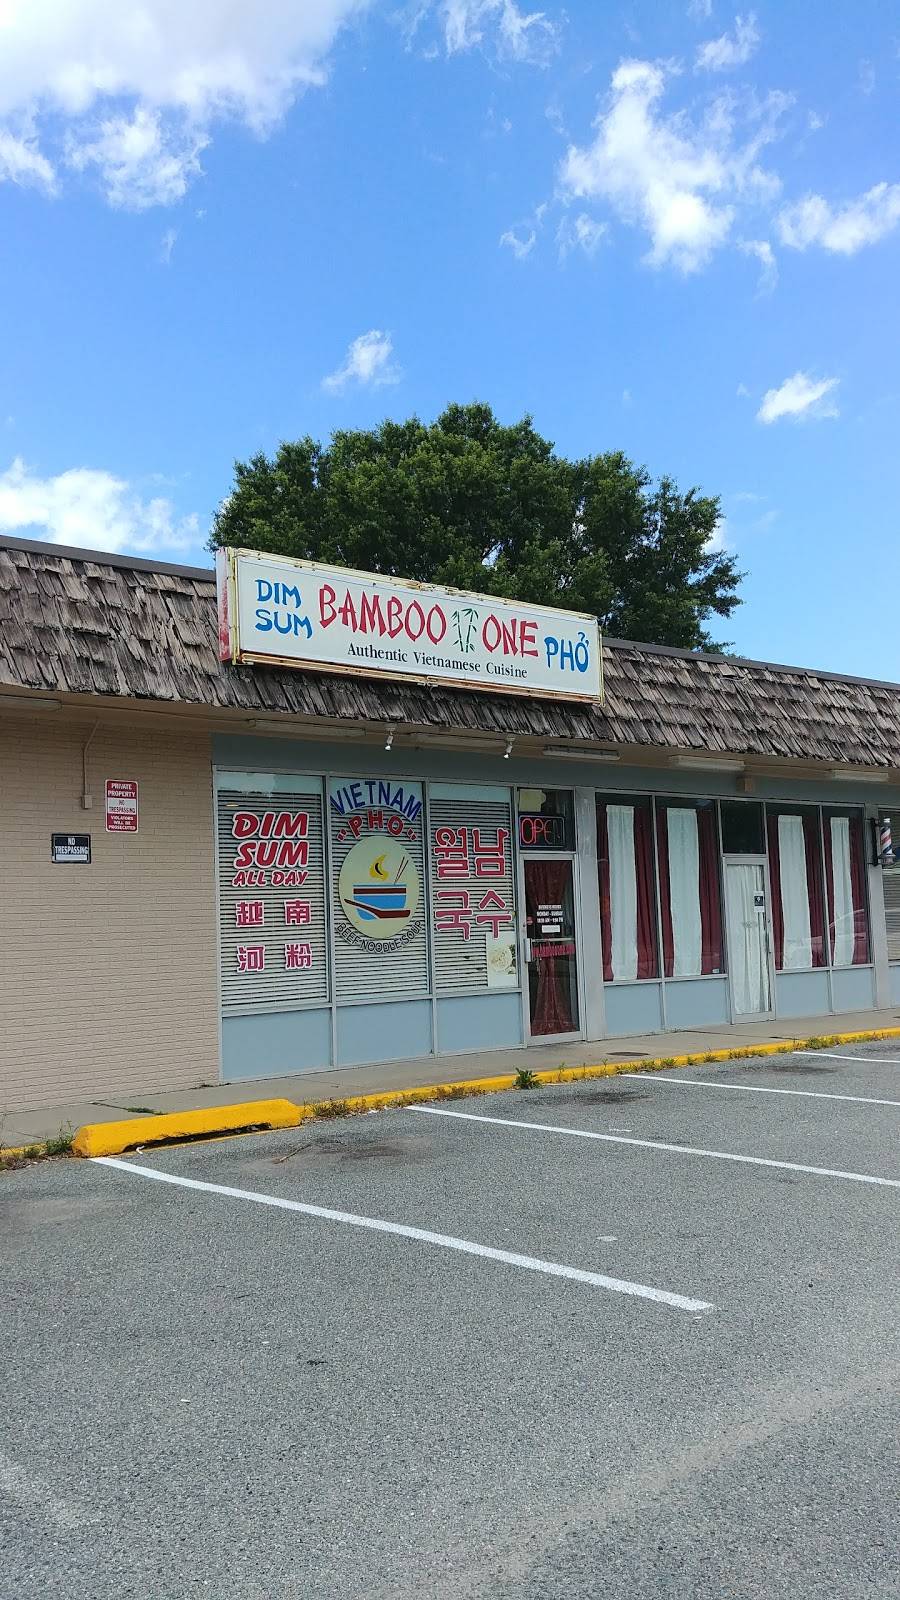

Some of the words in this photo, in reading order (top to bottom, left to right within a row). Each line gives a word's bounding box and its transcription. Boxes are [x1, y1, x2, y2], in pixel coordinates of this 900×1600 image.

[254, 579, 301, 609] DIM
[254, 608, 313, 639] SUM
[319, 583, 448, 646] BAMBOO
[481, 614, 540, 658] ONE
[347, 642, 408, 663] Authentic
[413, 651, 481, 673] Vietnamese
[486, 661, 528, 679] Cuisine
[330, 780, 422, 822] VIETNAM
[233, 812, 309, 838] DIM
[55, 846, 89, 855] TRESPASSING
[67, 837, 76, 846] NO
[234, 840, 309, 868] SUM
[232, 870, 267, 886] ALL
[272, 870, 309, 886] DAY
[336, 922, 361, 945] BEEF
[360, 939, 402, 953] NOODLE
[401, 920, 422, 945] SOUP
